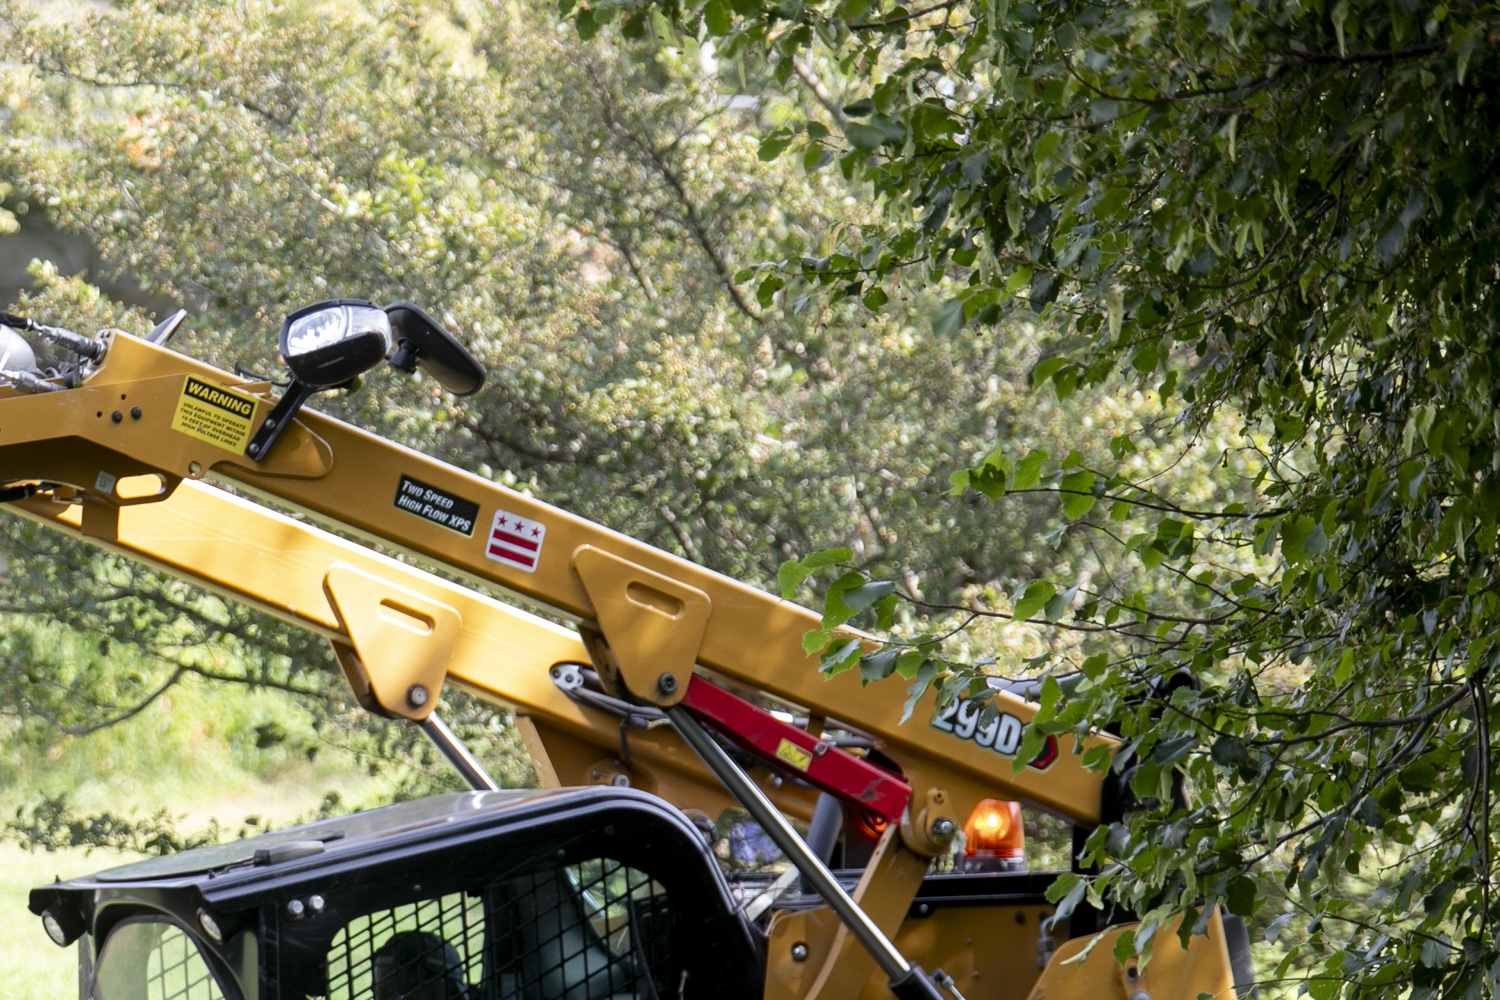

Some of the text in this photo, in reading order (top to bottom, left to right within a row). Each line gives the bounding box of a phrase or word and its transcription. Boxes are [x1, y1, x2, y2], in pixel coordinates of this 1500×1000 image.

[188, 382, 252, 415] WARNING
[180, 407, 246, 437] THIS EQUIPMENT WITHIN
[183, 402, 212, 417] UNLAWFUL
[222, 416, 246, 430] OPERATE
[181, 422, 237, 447] HIGH VOLTAGE LINES
[189, 417, 203, 427] FEET
[203, 422, 211, 430] OF
[211, 425, 241, 442] OVERHEAD
[449, 514, 472, 532] XPS
